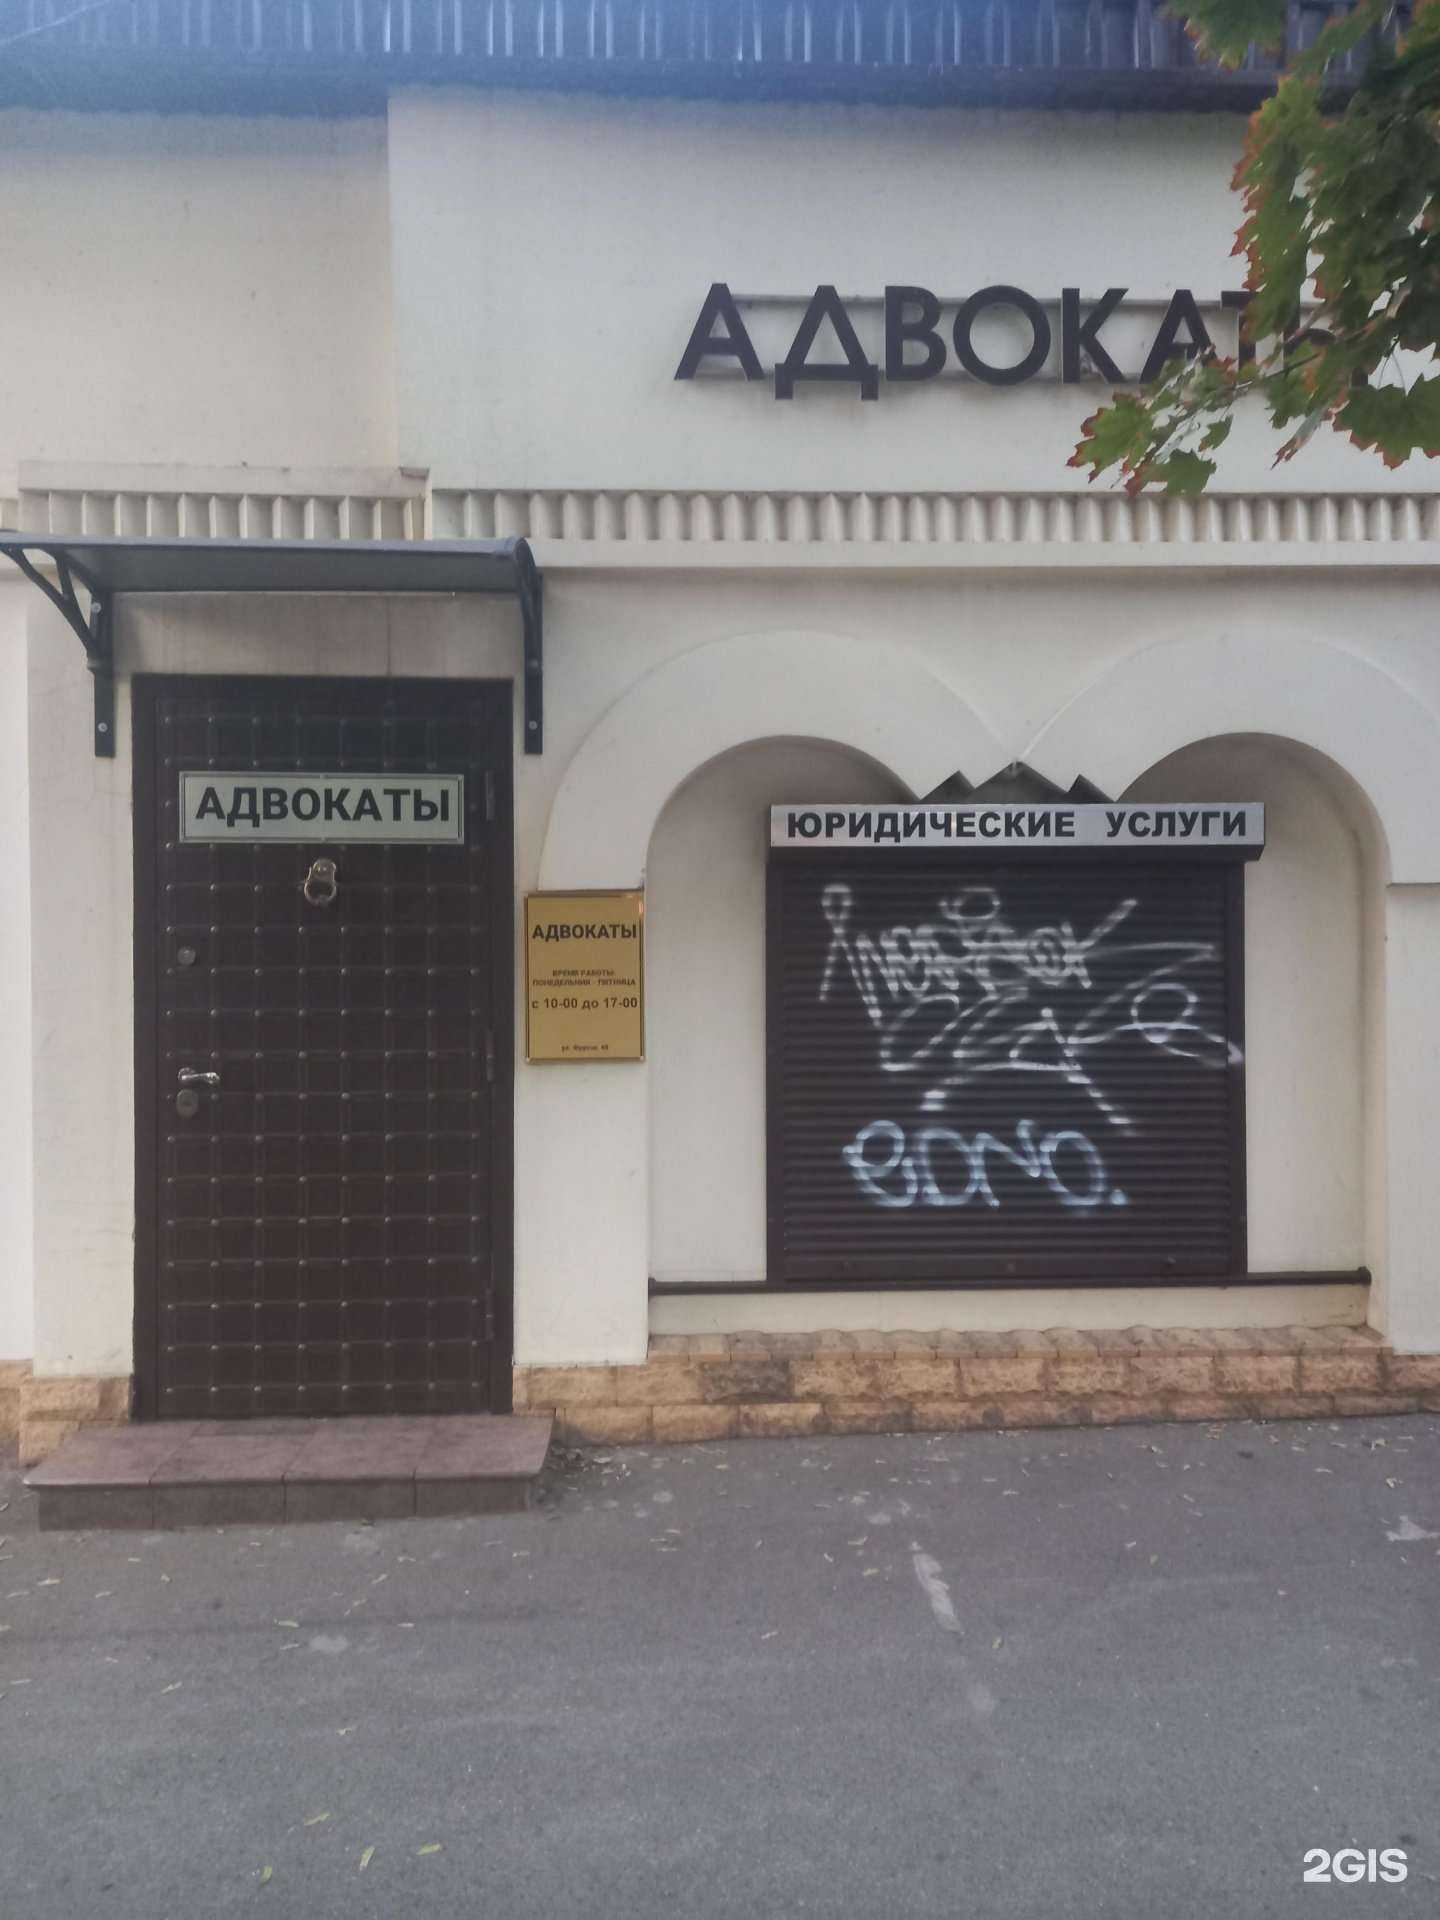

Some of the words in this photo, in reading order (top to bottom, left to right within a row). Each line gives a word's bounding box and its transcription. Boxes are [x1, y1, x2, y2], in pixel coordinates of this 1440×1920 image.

[195, 786, 450, 828] АДВОКАТЫ
[787, 811, 1076, 843] ЮРИДИЧЕСКИЕ
[1105, 810, 1247, 837] УСЛУГИ
[532, 924, 637, 942] АДВОКАТЫ
[532, 1000, 539, 1009] с
[543, 998, 578, 1009] 10-00
[582, 1001, 599, 1010] до
[603, 997, 638, 1009] 17-00
